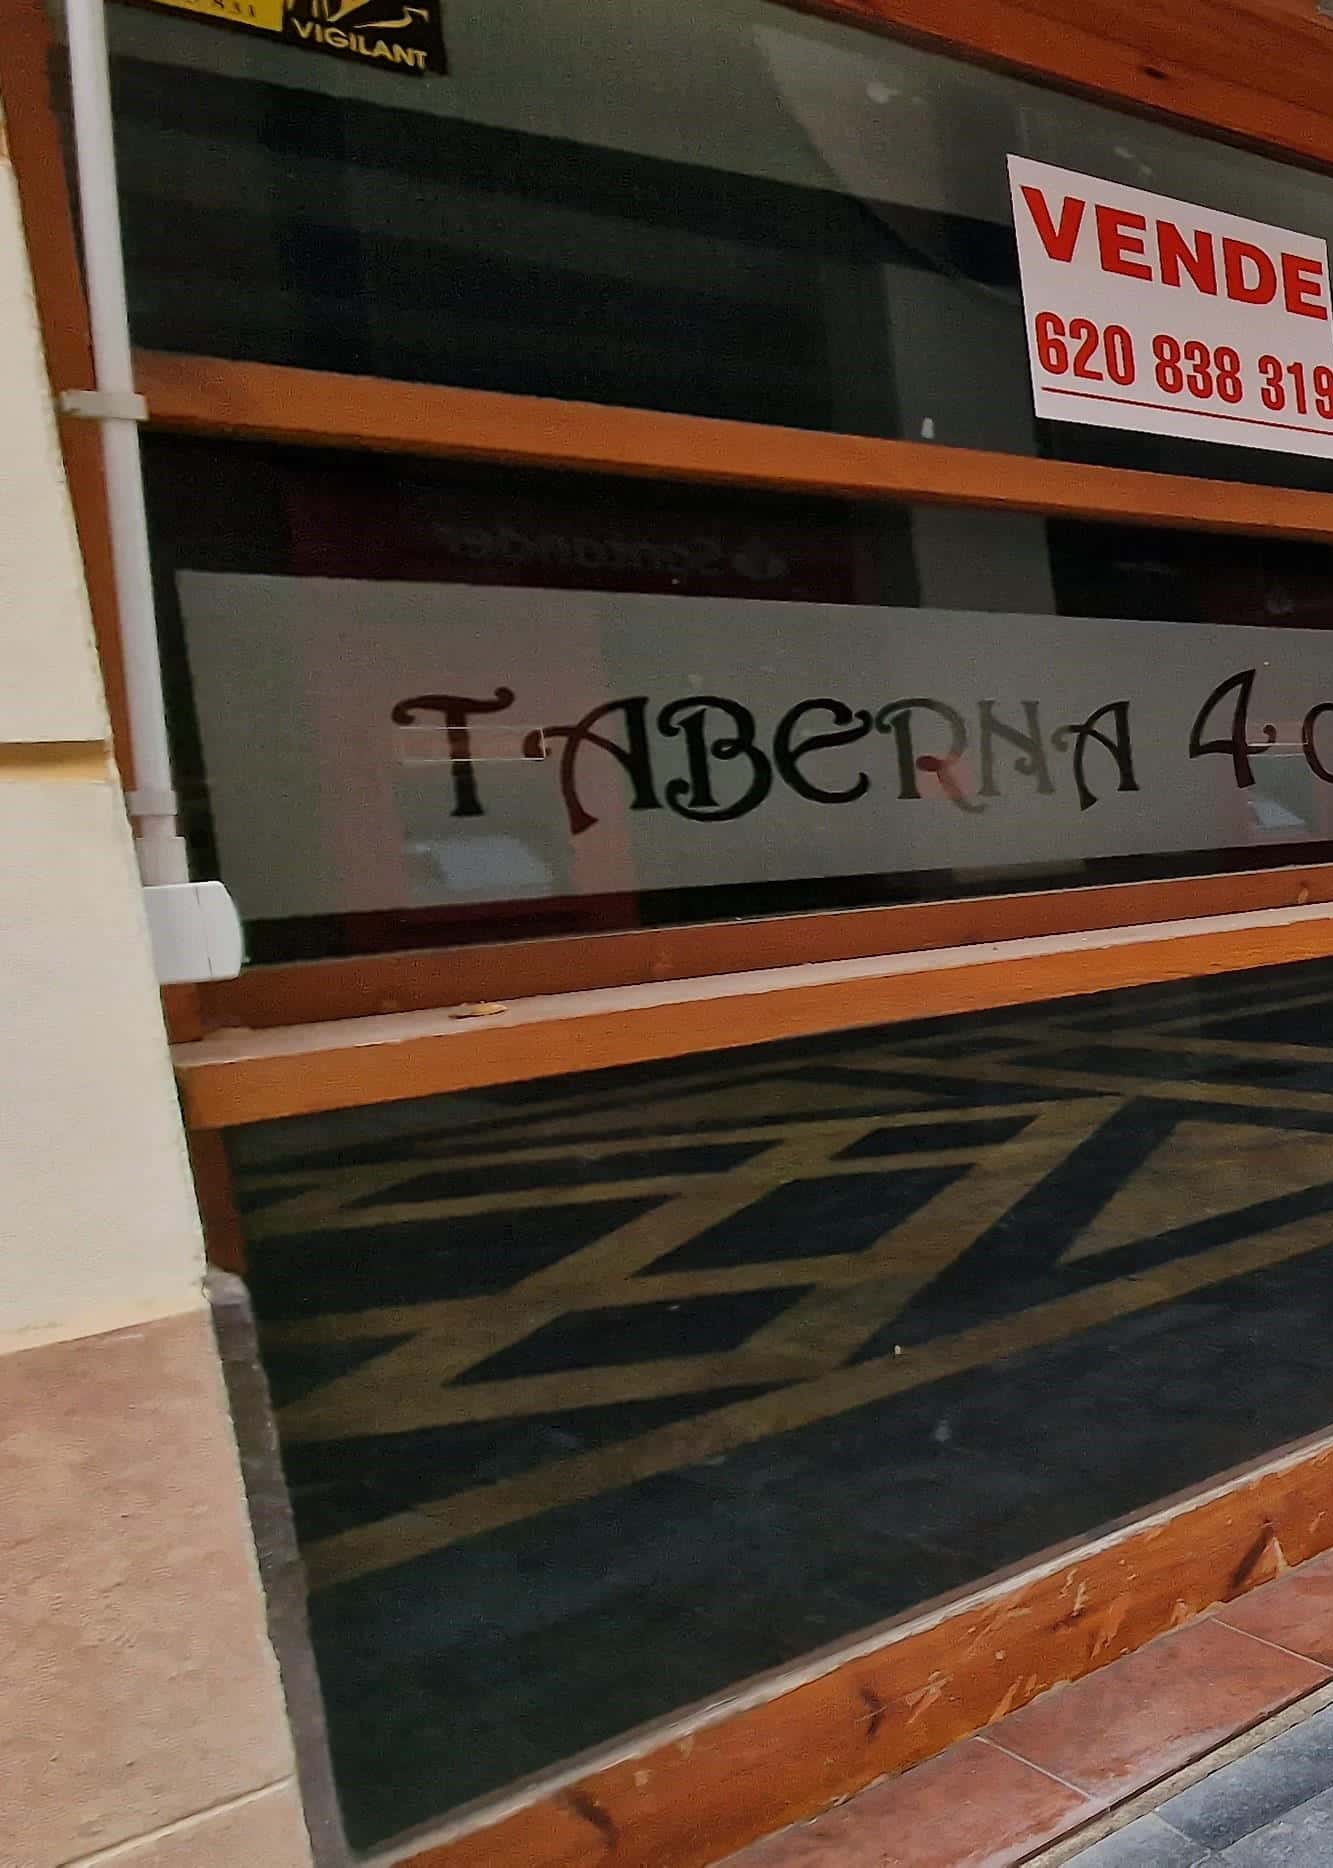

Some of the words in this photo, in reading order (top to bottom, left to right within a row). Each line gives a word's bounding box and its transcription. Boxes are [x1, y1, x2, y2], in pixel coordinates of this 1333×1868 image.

[291, 17, 429, 70] VIGILANT
[1020, 185, 1329, 321] VENDE
[1035, 311, 1136, 386] 620
[1152, 334, 1244, 404] 838
[390, 685, 1140, 835] TABERNA
[1188, 668, 1277, 789] 4
